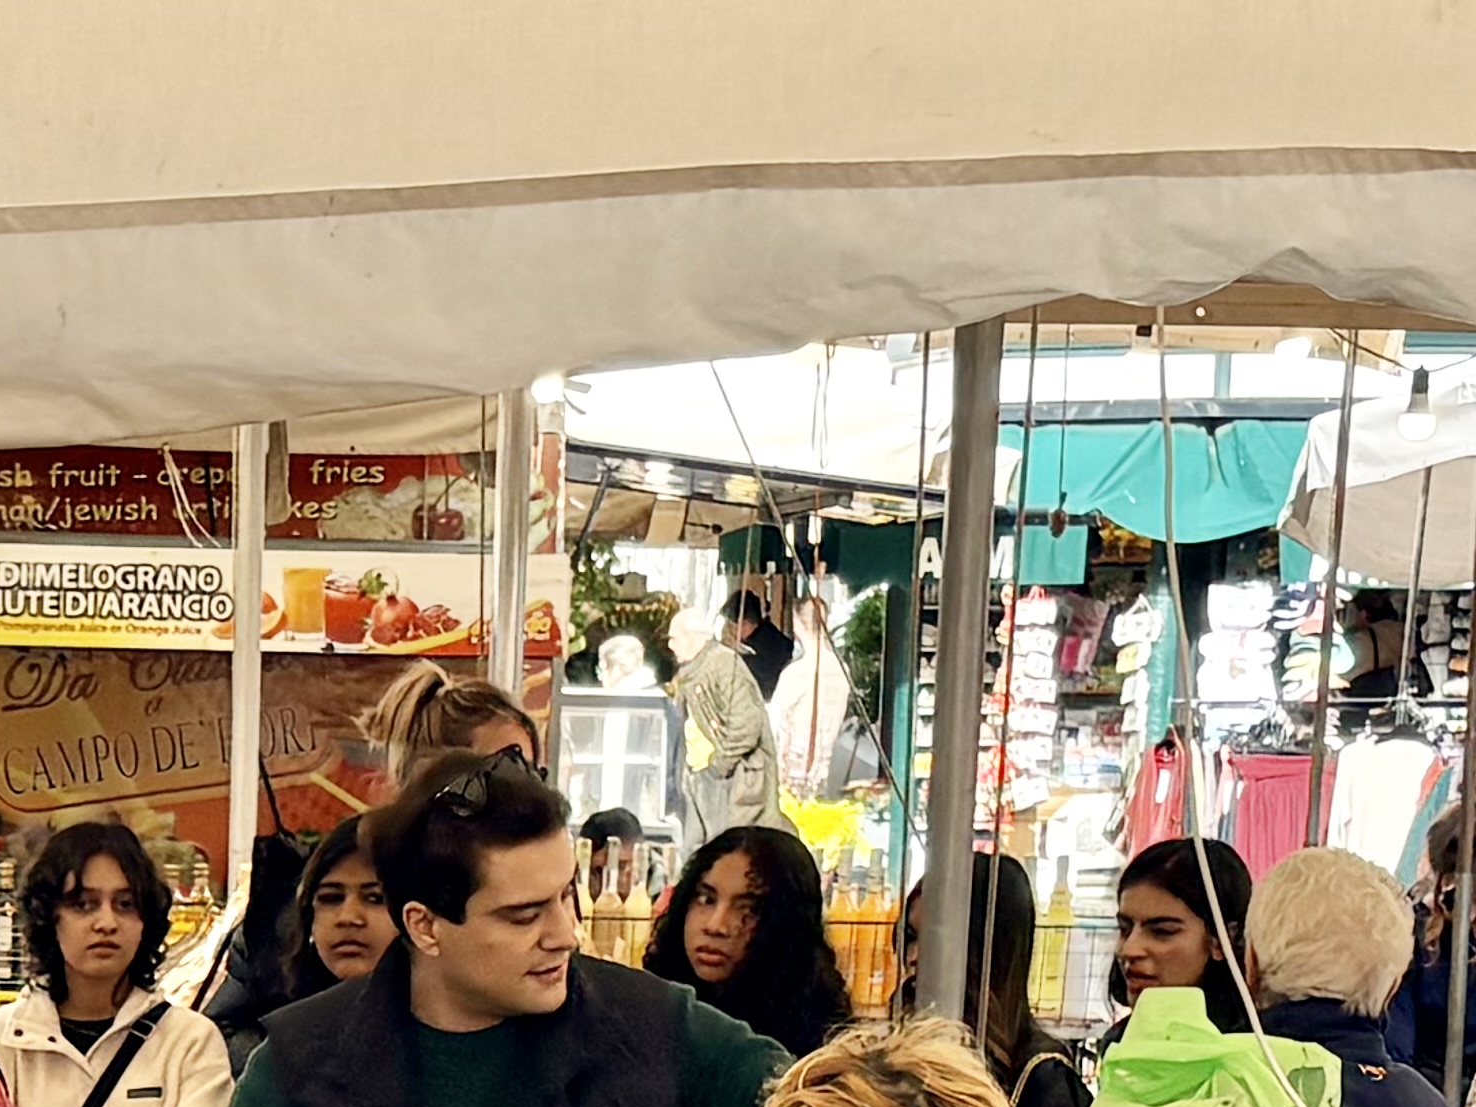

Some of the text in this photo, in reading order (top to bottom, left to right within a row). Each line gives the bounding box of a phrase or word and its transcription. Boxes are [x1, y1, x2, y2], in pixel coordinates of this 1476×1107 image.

[48, 462, 122, 488] fruit
[309, 458, 386, 484] fries
[31, 561, 222, 593] MELOGRANO
[62, 589, 97, 618] DI
[96, 591, 234, 621] ARANCIO
[3, 732, 140, 795] CAMPO
